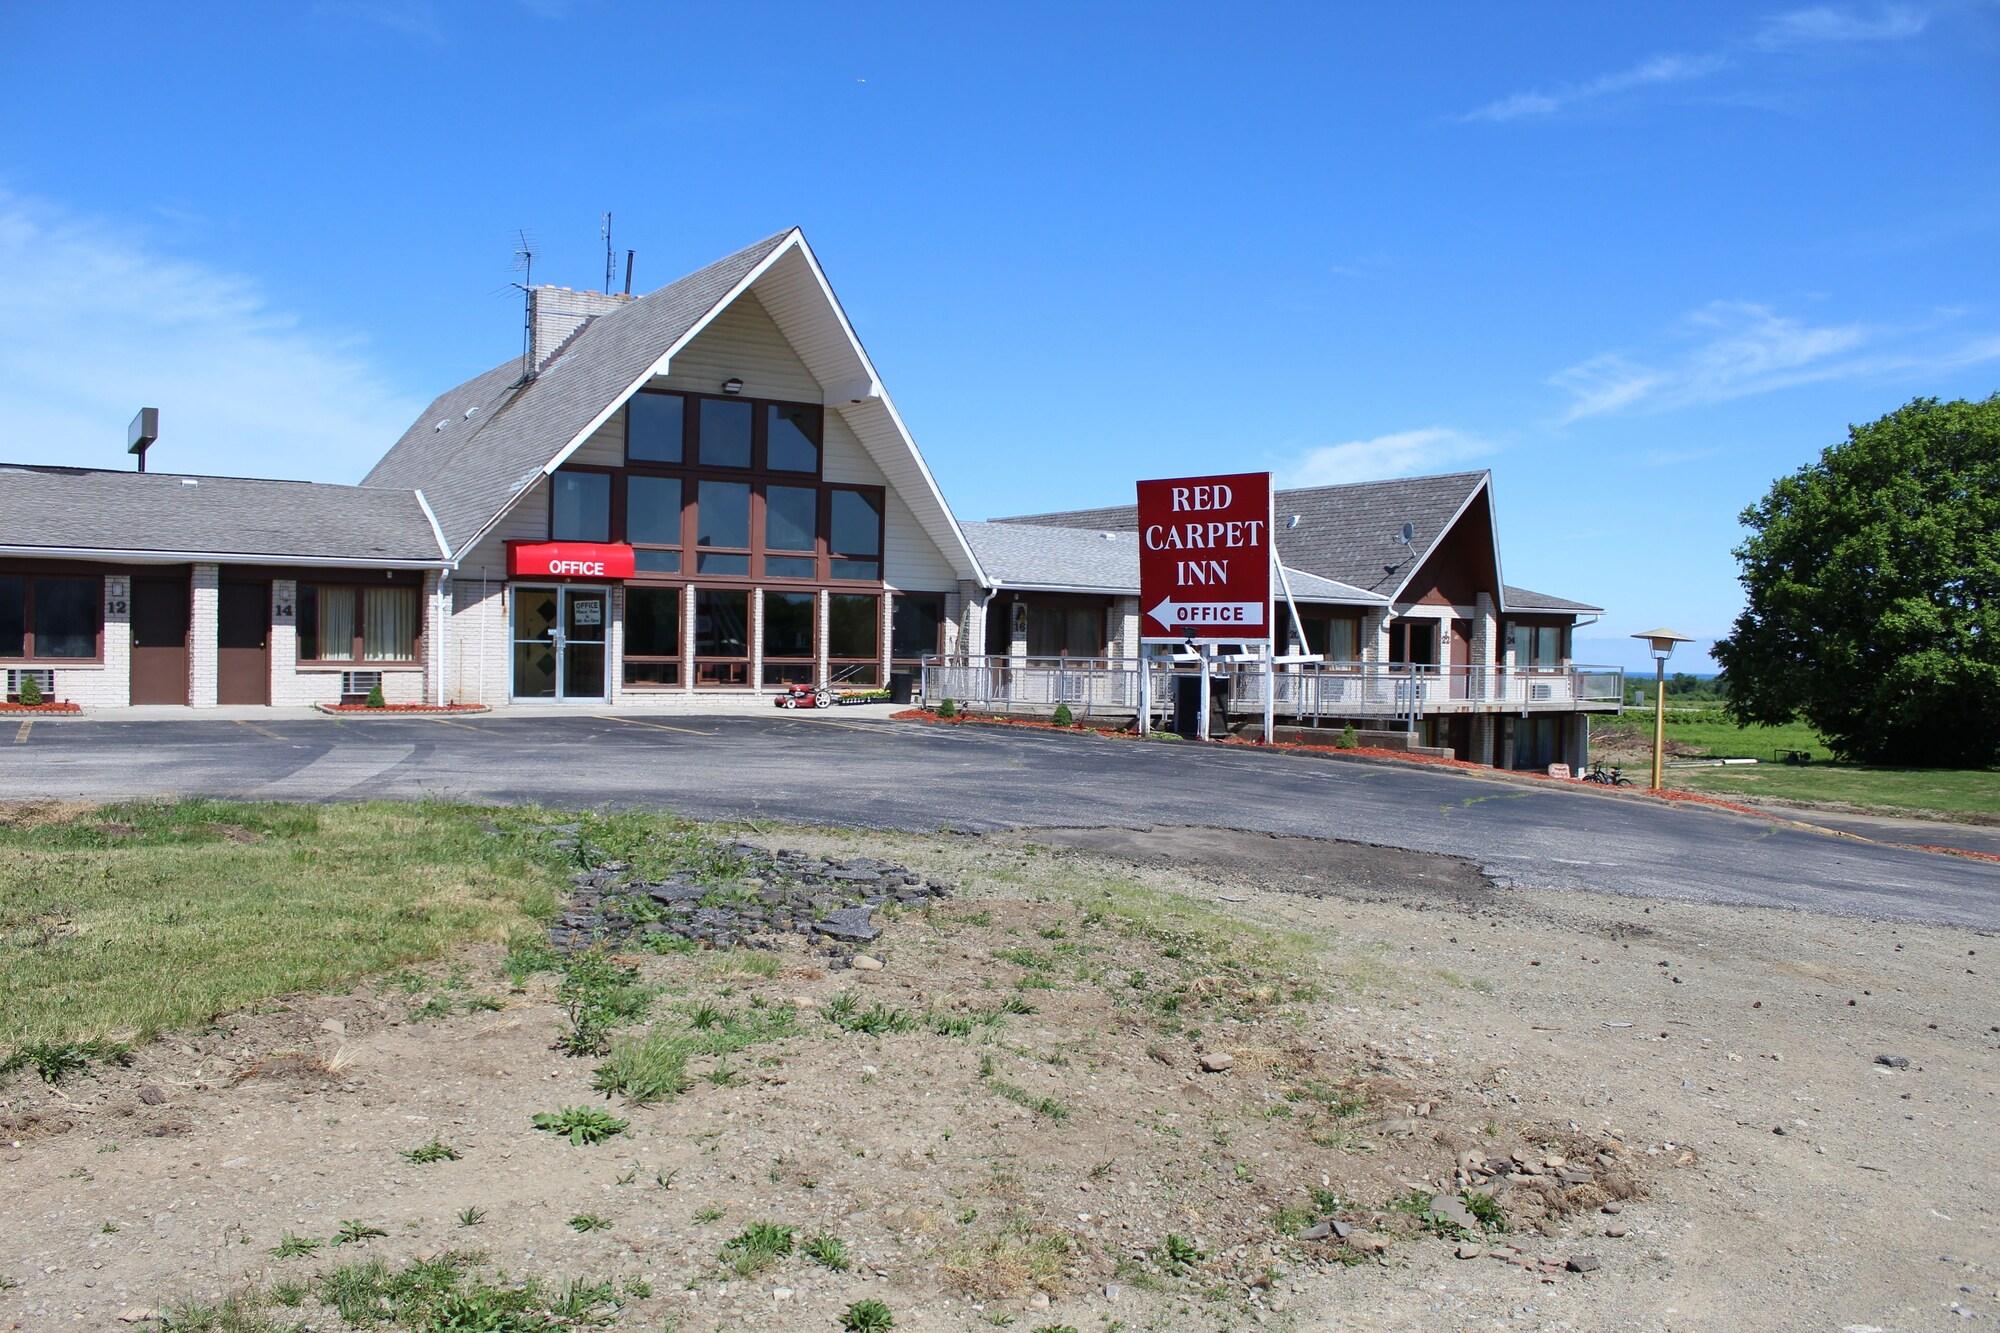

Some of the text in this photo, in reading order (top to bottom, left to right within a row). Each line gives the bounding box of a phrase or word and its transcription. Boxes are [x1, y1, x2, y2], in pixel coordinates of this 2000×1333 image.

[1172, 484, 1232, 512] RED
[1145, 521, 1264, 551] CARPET
[549, 560, 604, 576] OFFICE
[1177, 560, 1229, 586] INN
[108, 600, 127, 614] 12
[276, 604, 293, 617] 14
[1176, 606, 1244, 622] OFFICE
[1441, 635, 1451, 645] 22
